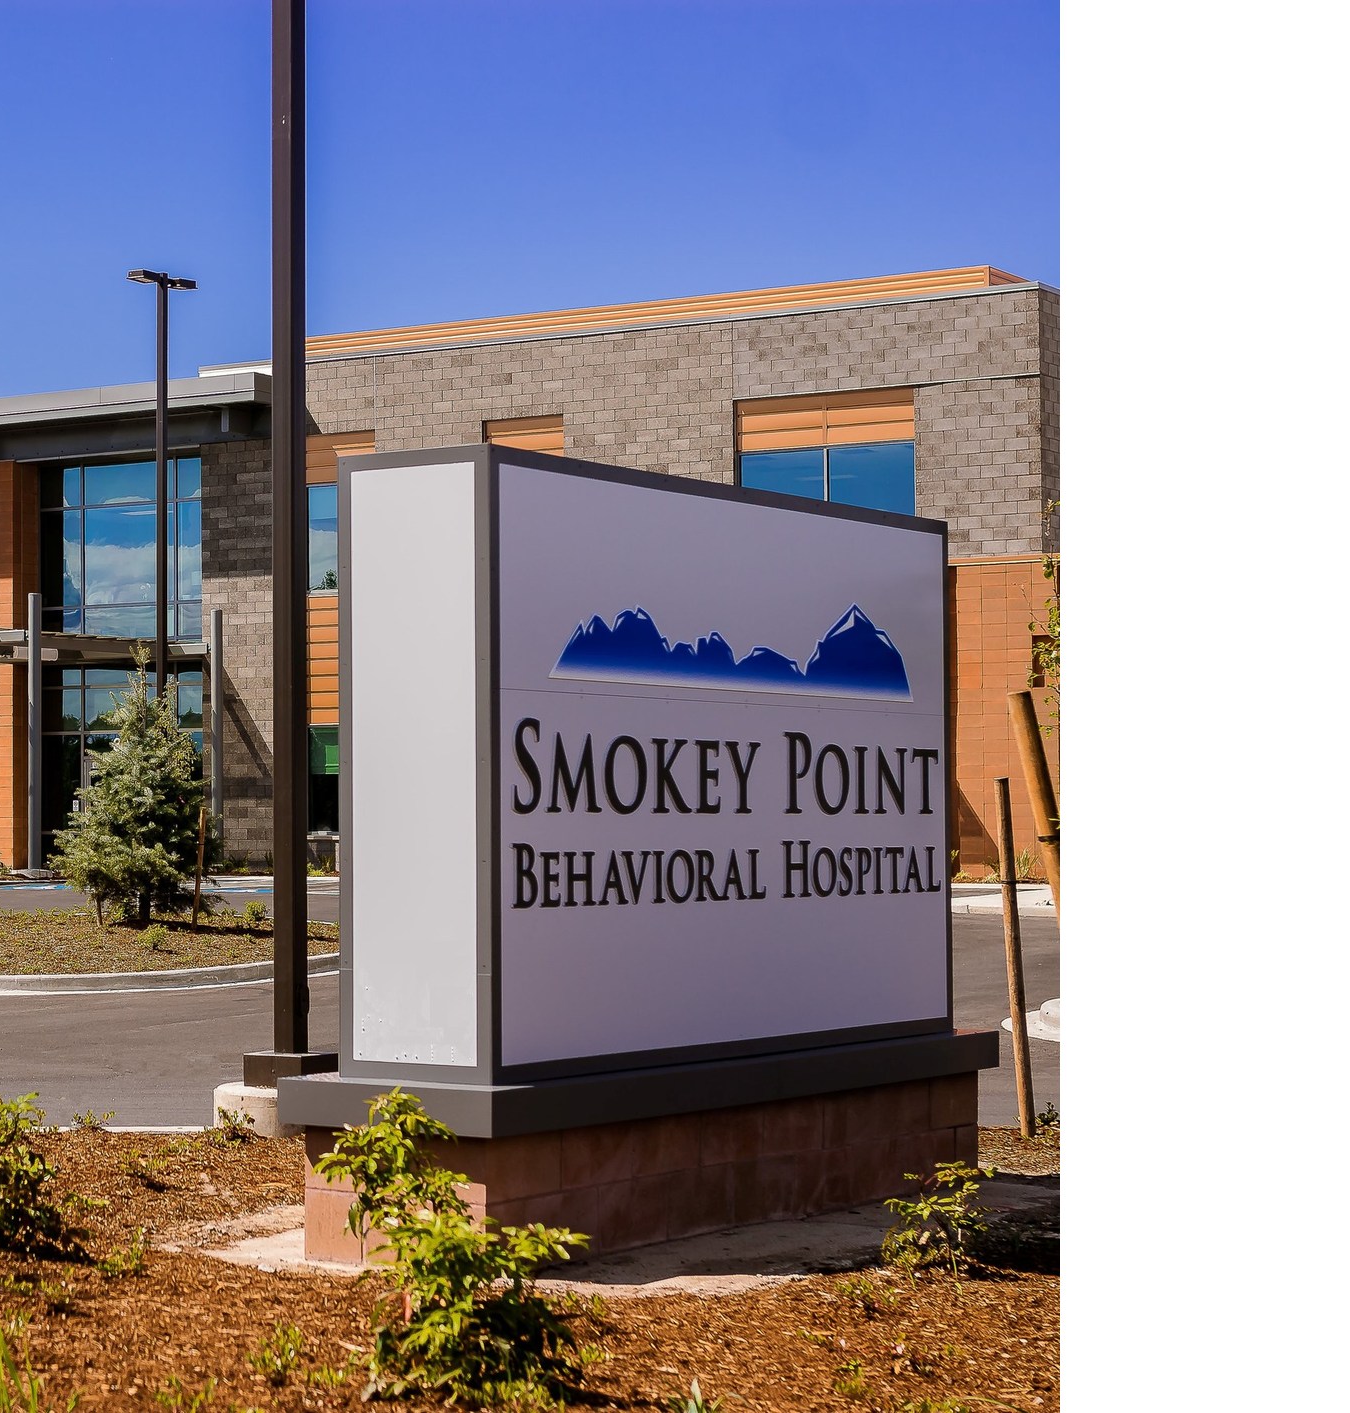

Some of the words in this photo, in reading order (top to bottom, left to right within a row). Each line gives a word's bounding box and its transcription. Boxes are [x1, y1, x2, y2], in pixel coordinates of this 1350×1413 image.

[512, 716, 762, 816] SMOKEY
[781, 730, 940, 816] POINT
[510, 841, 767, 910] BEHAVIORAL
[780, 839, 943, 900] HOSPITAL
